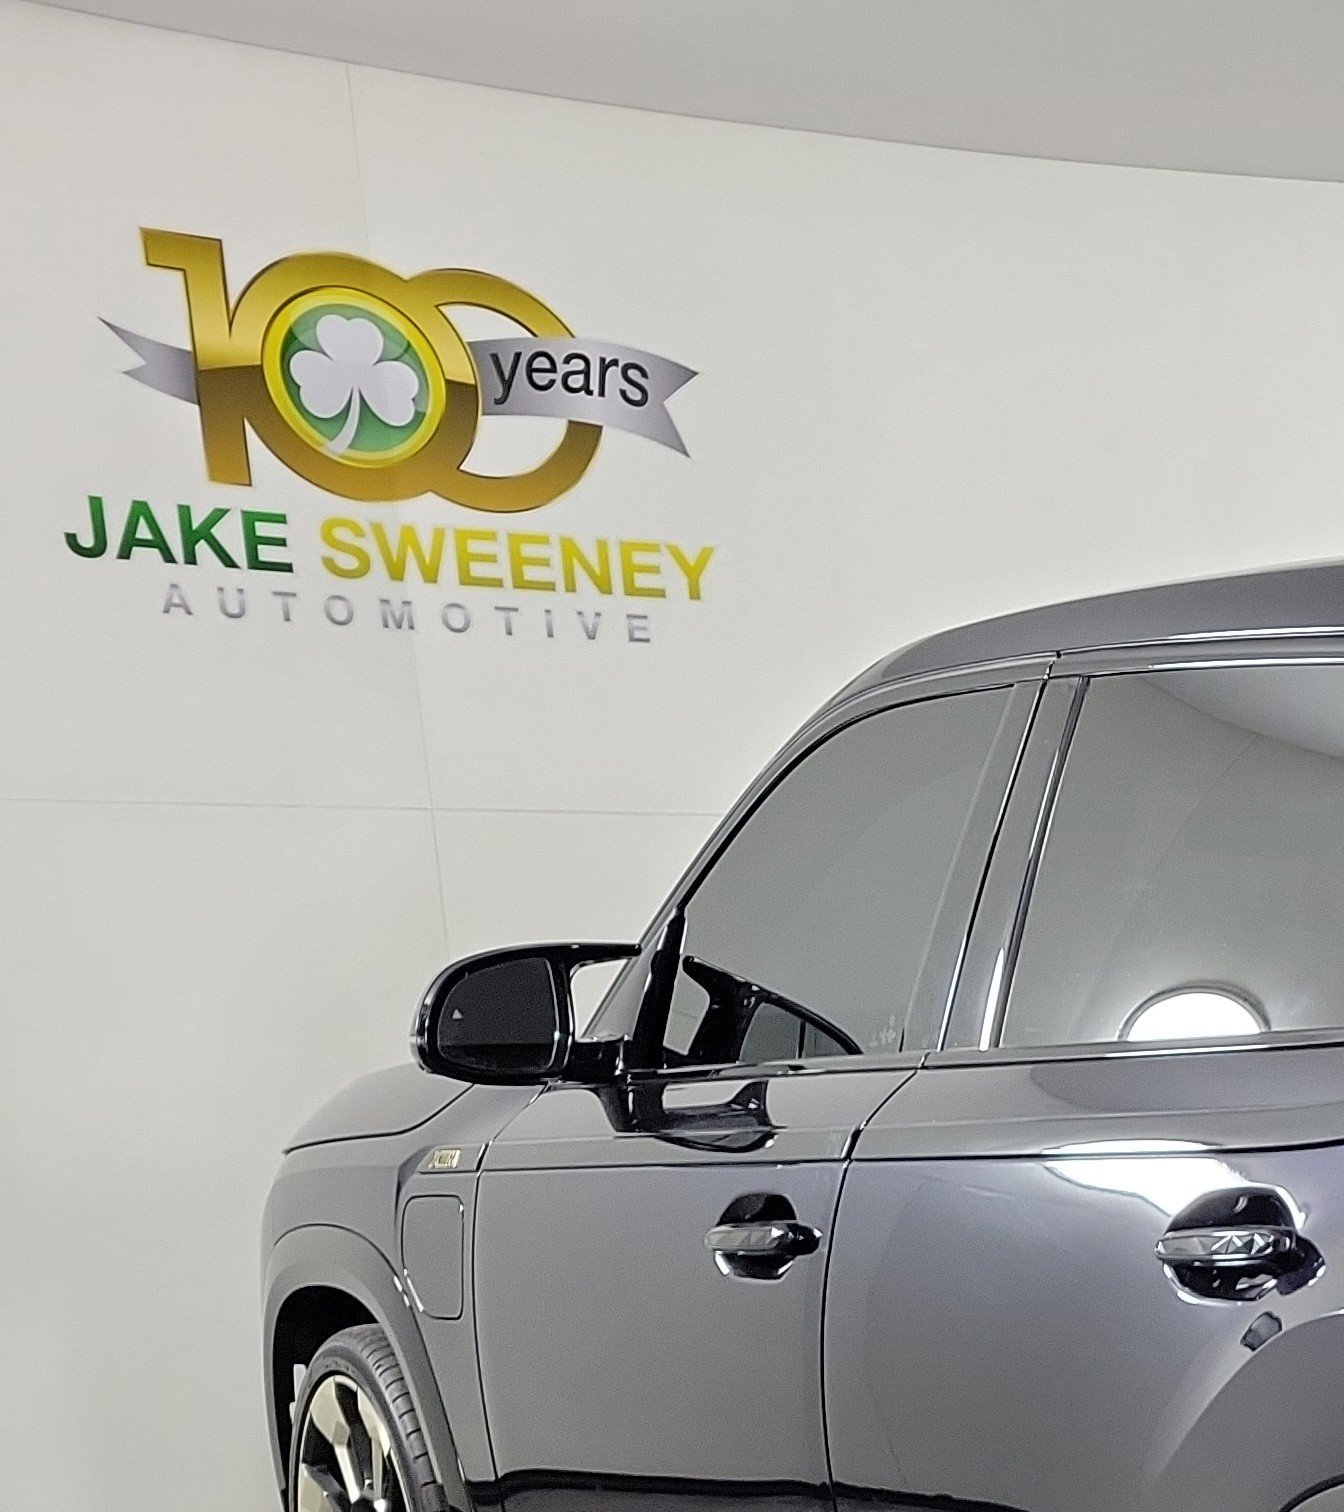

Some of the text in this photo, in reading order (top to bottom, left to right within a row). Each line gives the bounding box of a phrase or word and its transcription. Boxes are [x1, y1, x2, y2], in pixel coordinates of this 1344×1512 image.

[139, 226, 651, 514] 100 years
[64, 495, 716, 601] JAKE SWEENEY
[161, 582, 652, 644] AUTOMOTIVE
